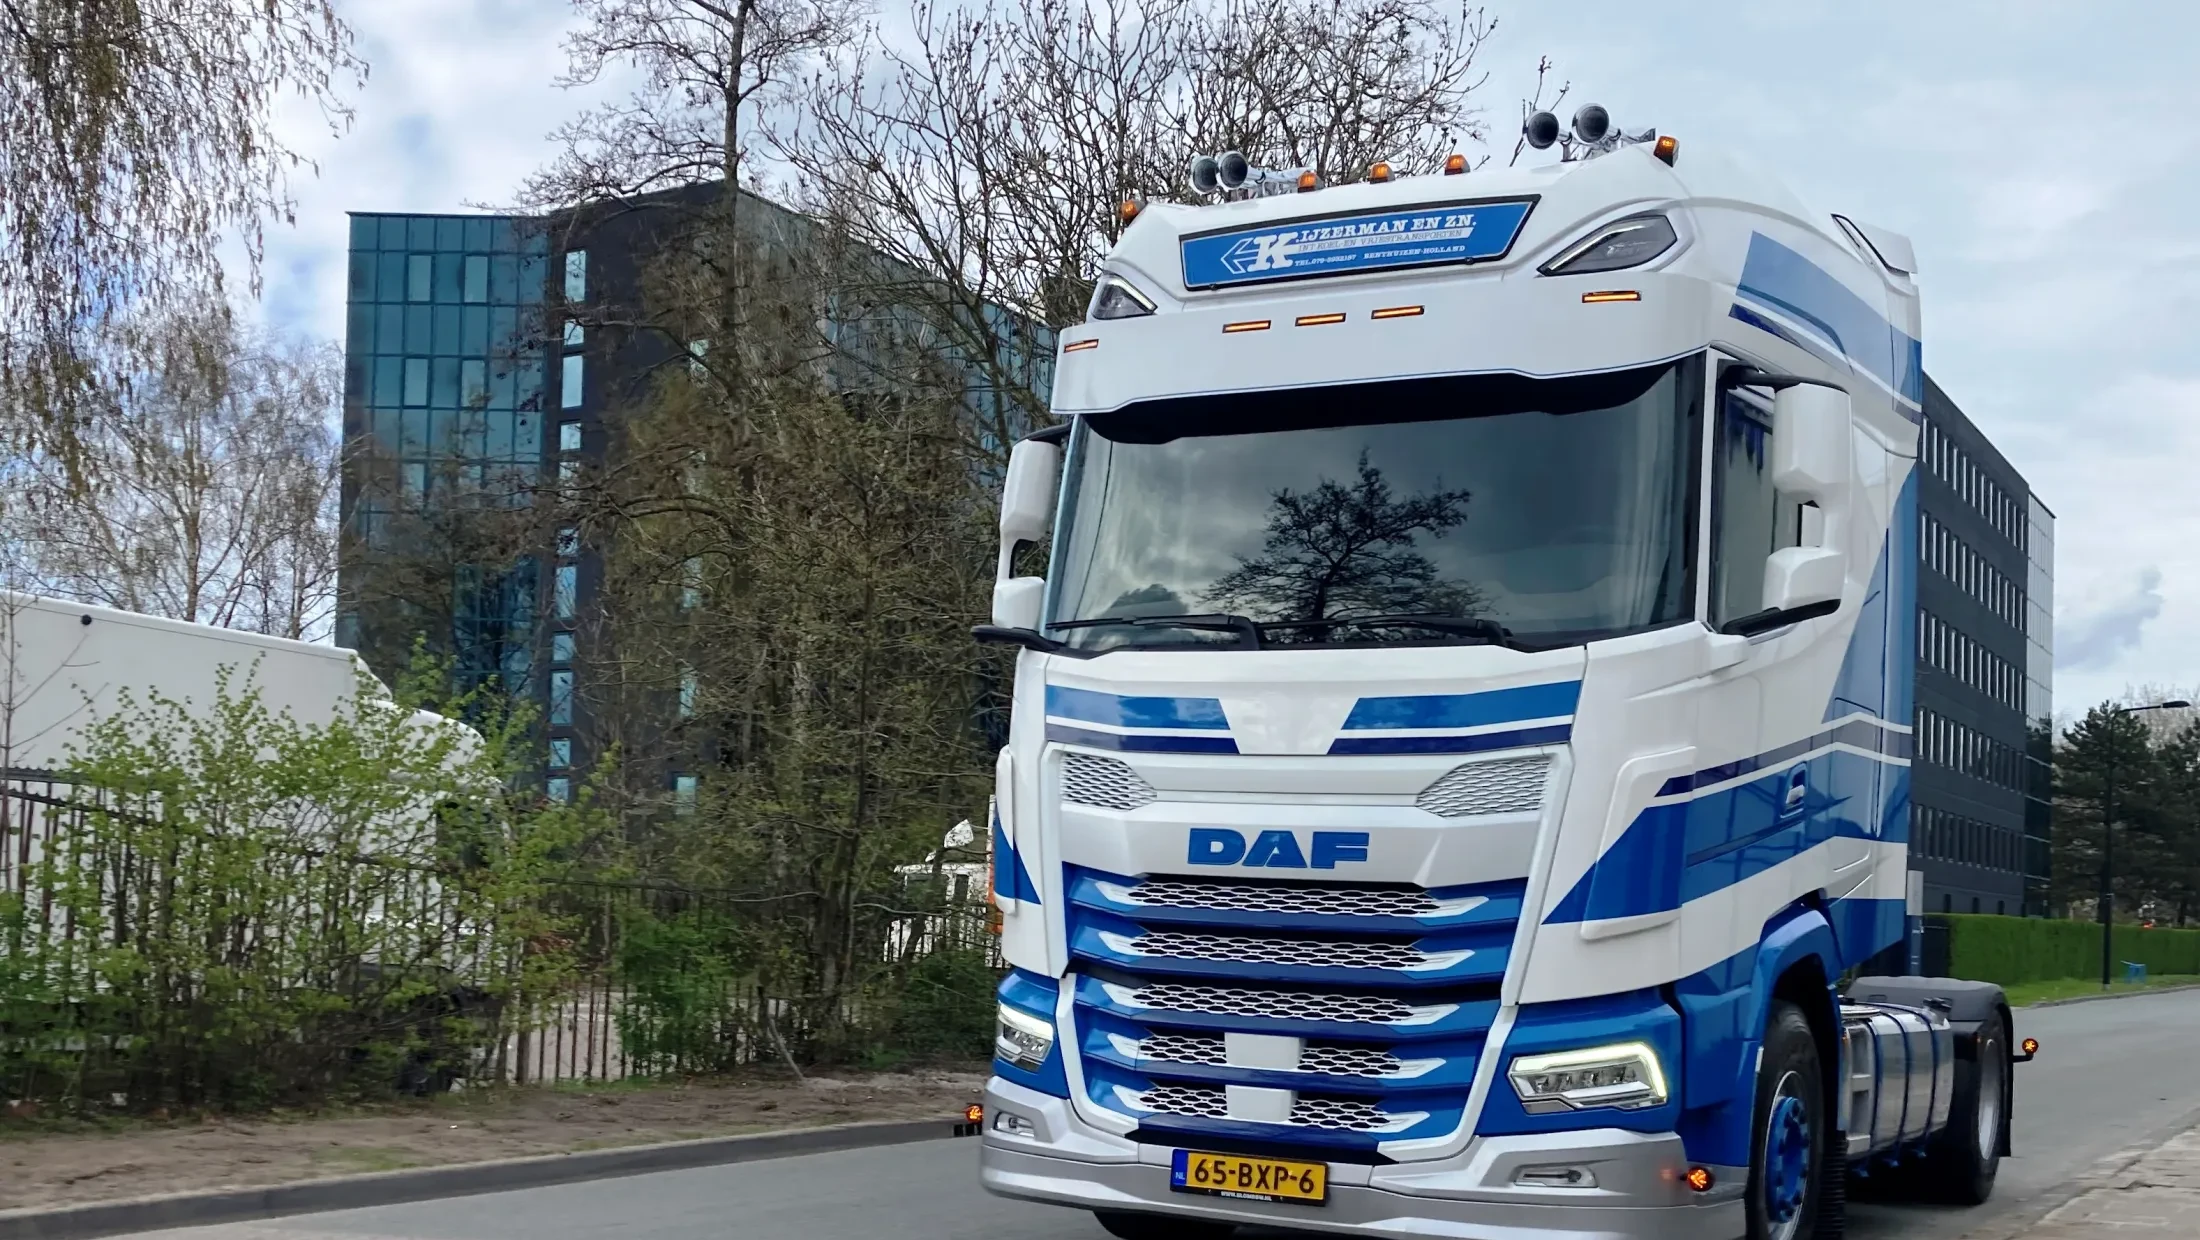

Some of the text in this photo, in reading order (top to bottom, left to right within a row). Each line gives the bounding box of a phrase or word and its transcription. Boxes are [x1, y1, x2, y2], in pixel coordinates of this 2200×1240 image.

[1410, 216, 1442, 231] EN
[1444, 213, 1477, 228] ZN.
[1360, 228, 1463, 246] VRIESTRANSPORTEN
[1187, 827, 1370, 869] DAF
[1174, 1171, 1186, 1181] NL
[1194, 1158, 1315, 1194] 65-BXP-6
